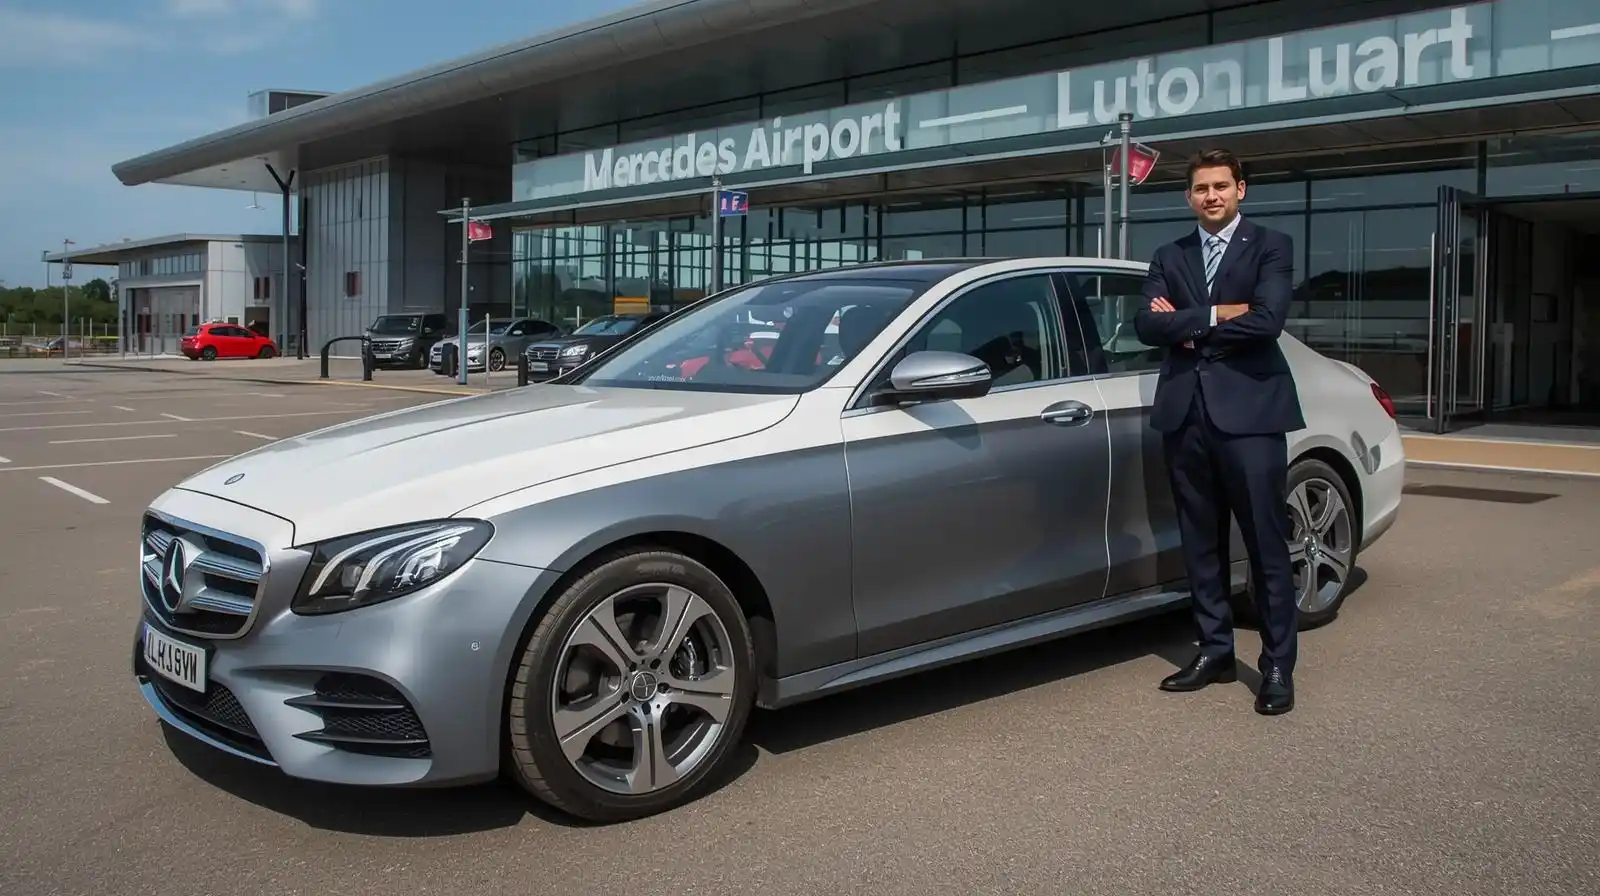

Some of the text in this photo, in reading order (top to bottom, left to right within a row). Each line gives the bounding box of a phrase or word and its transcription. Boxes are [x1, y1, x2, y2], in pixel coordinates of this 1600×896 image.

[583, 132, 736, 192] Mercedes
[742, 102, 901, 174] Airport
[1057, 57, 1242, 128] Luton
[1268, 8, 1474, 102] Luart
